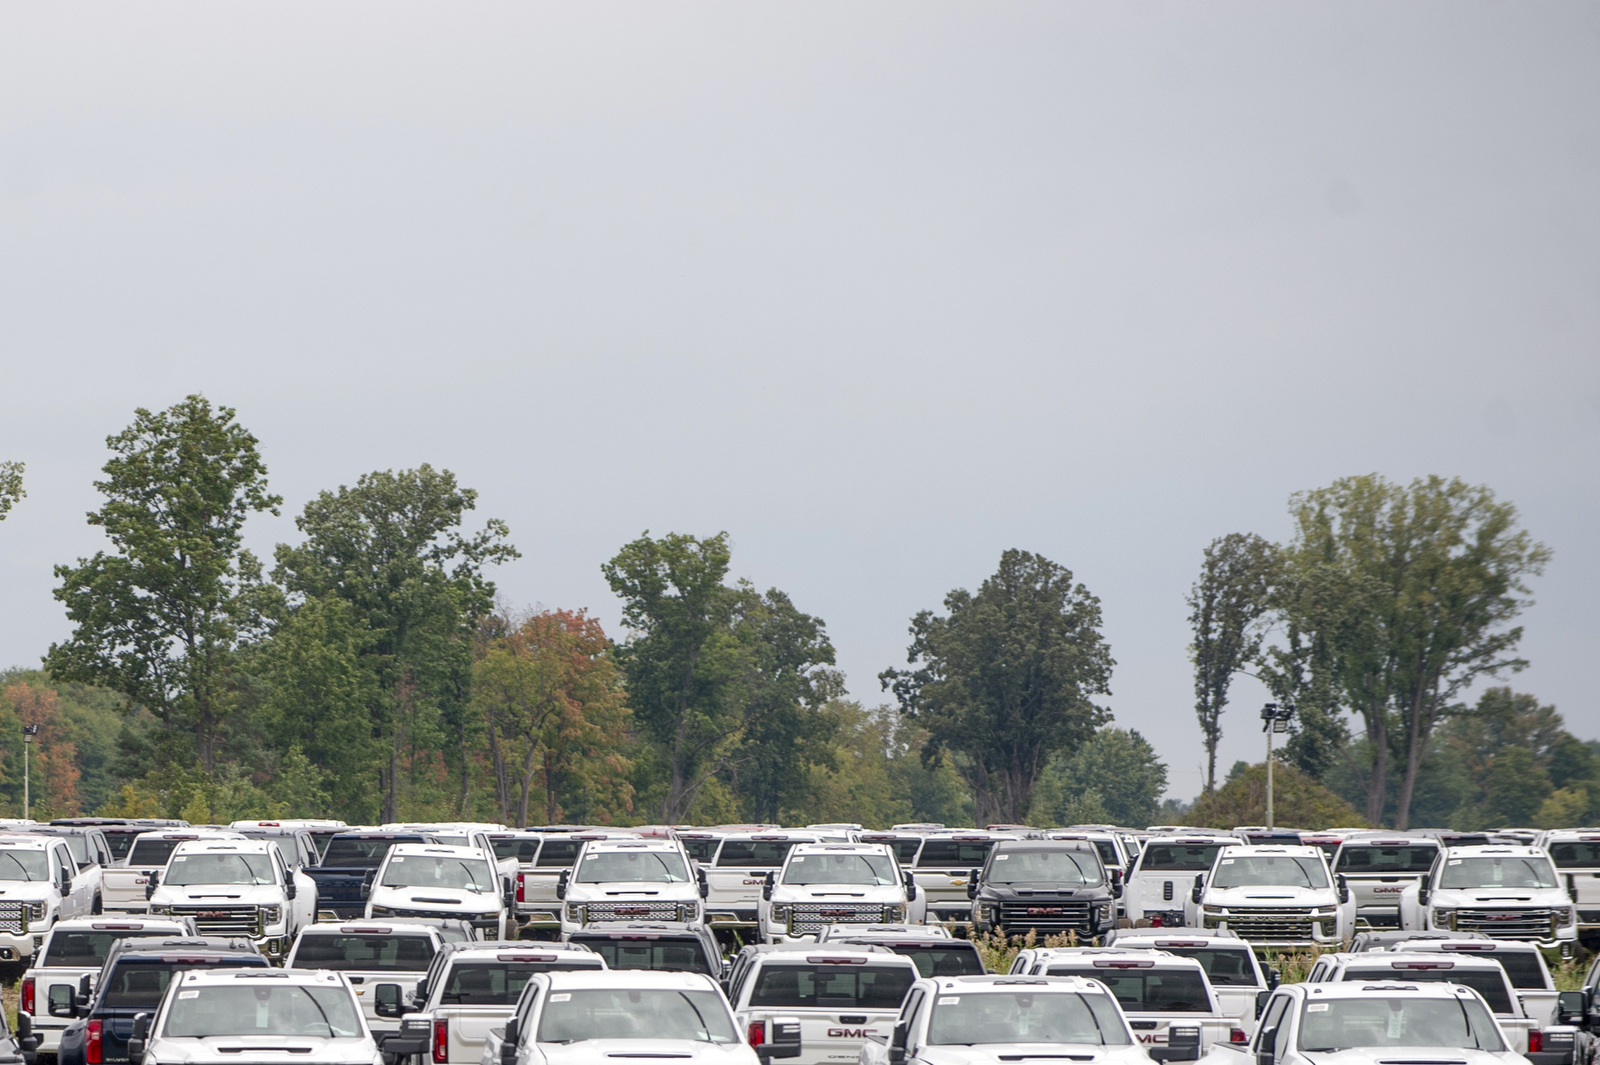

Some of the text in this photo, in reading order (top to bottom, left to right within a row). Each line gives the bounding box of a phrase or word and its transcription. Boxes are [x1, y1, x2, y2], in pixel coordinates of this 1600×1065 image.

[615, 907, 650, 915] GMC
[1027, 907, 1062, 915] GMC
[1135, 1034, 1168, 1043] MC
